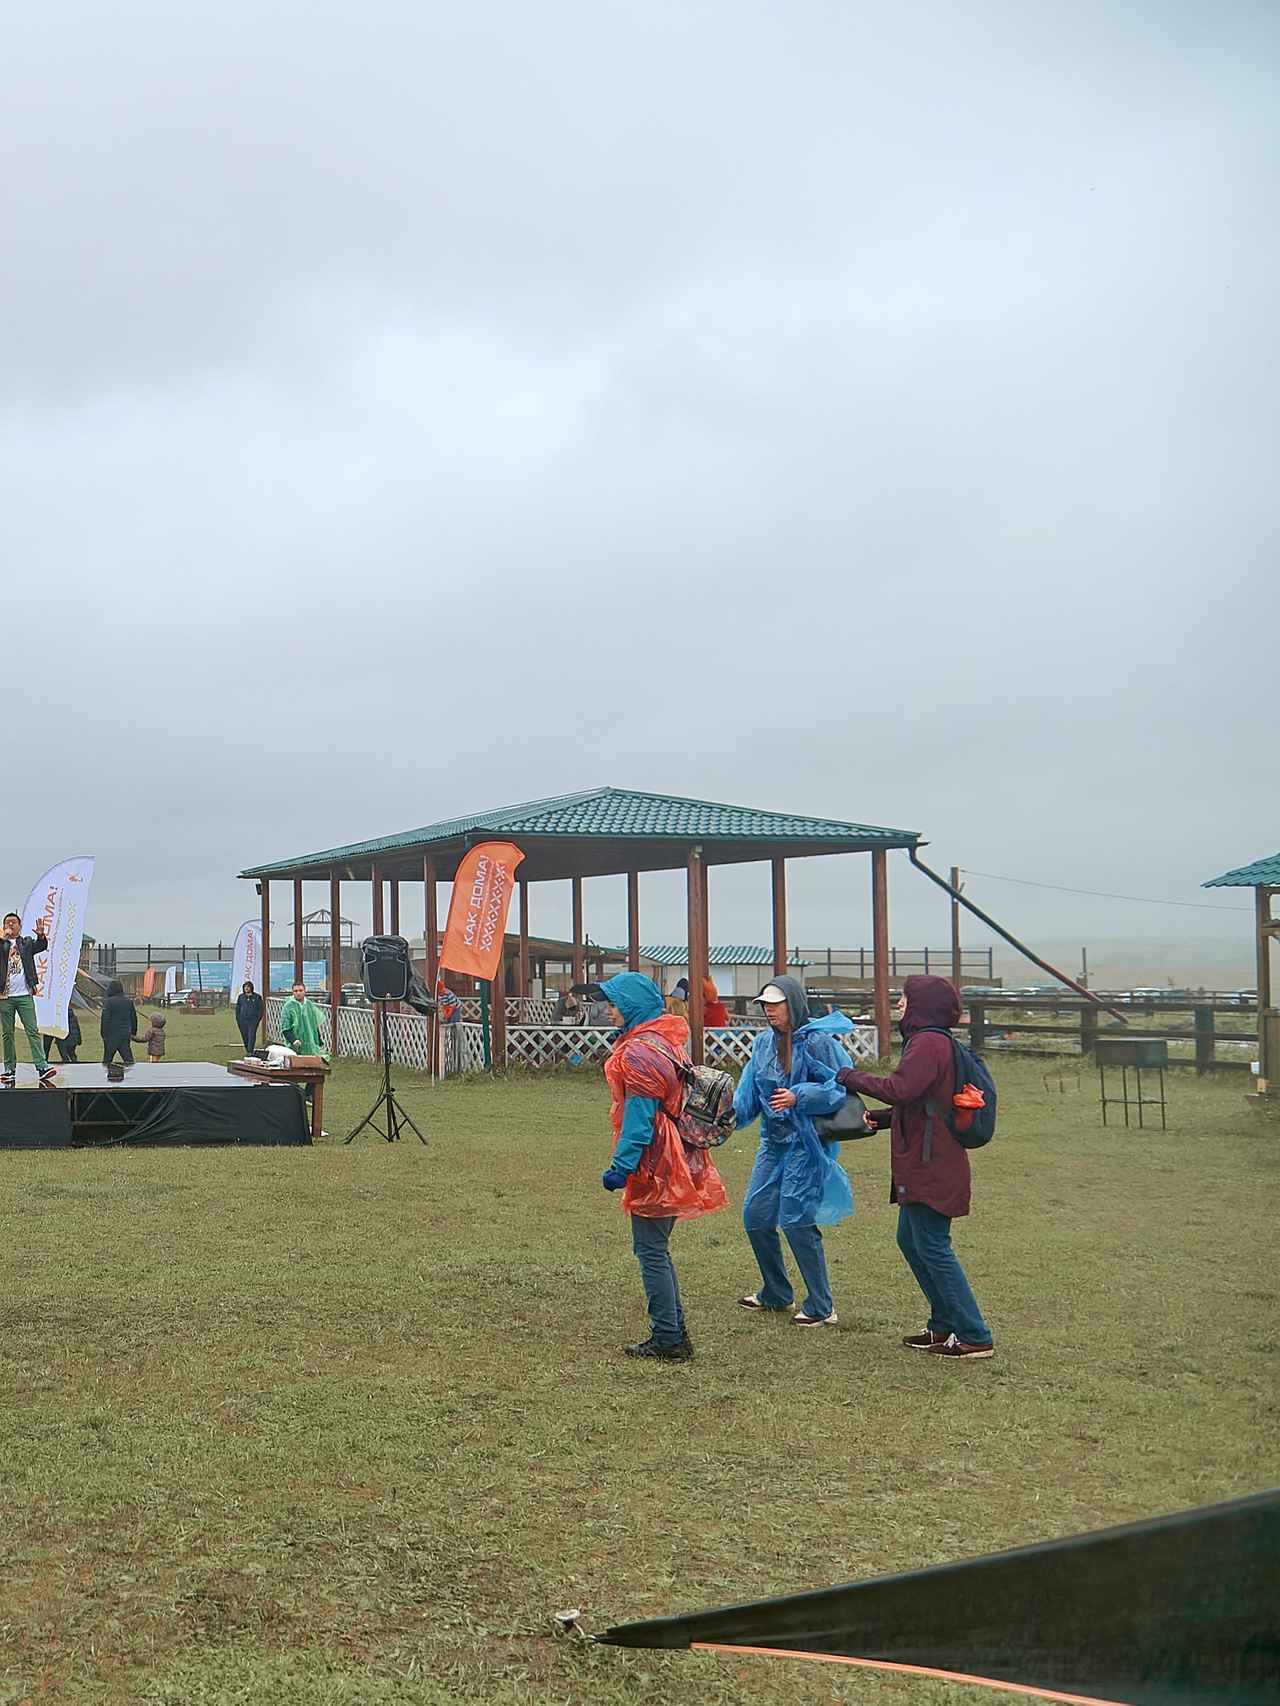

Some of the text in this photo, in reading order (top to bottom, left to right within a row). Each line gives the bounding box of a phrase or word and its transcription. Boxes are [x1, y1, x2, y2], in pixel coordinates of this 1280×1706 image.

[470, 854, 490, 909] ДОМА!
[35, 885, 59, 998] КАК ОМА!
[463, 912, 478, 946] КАК
[244, 965, 252, 983] АК
